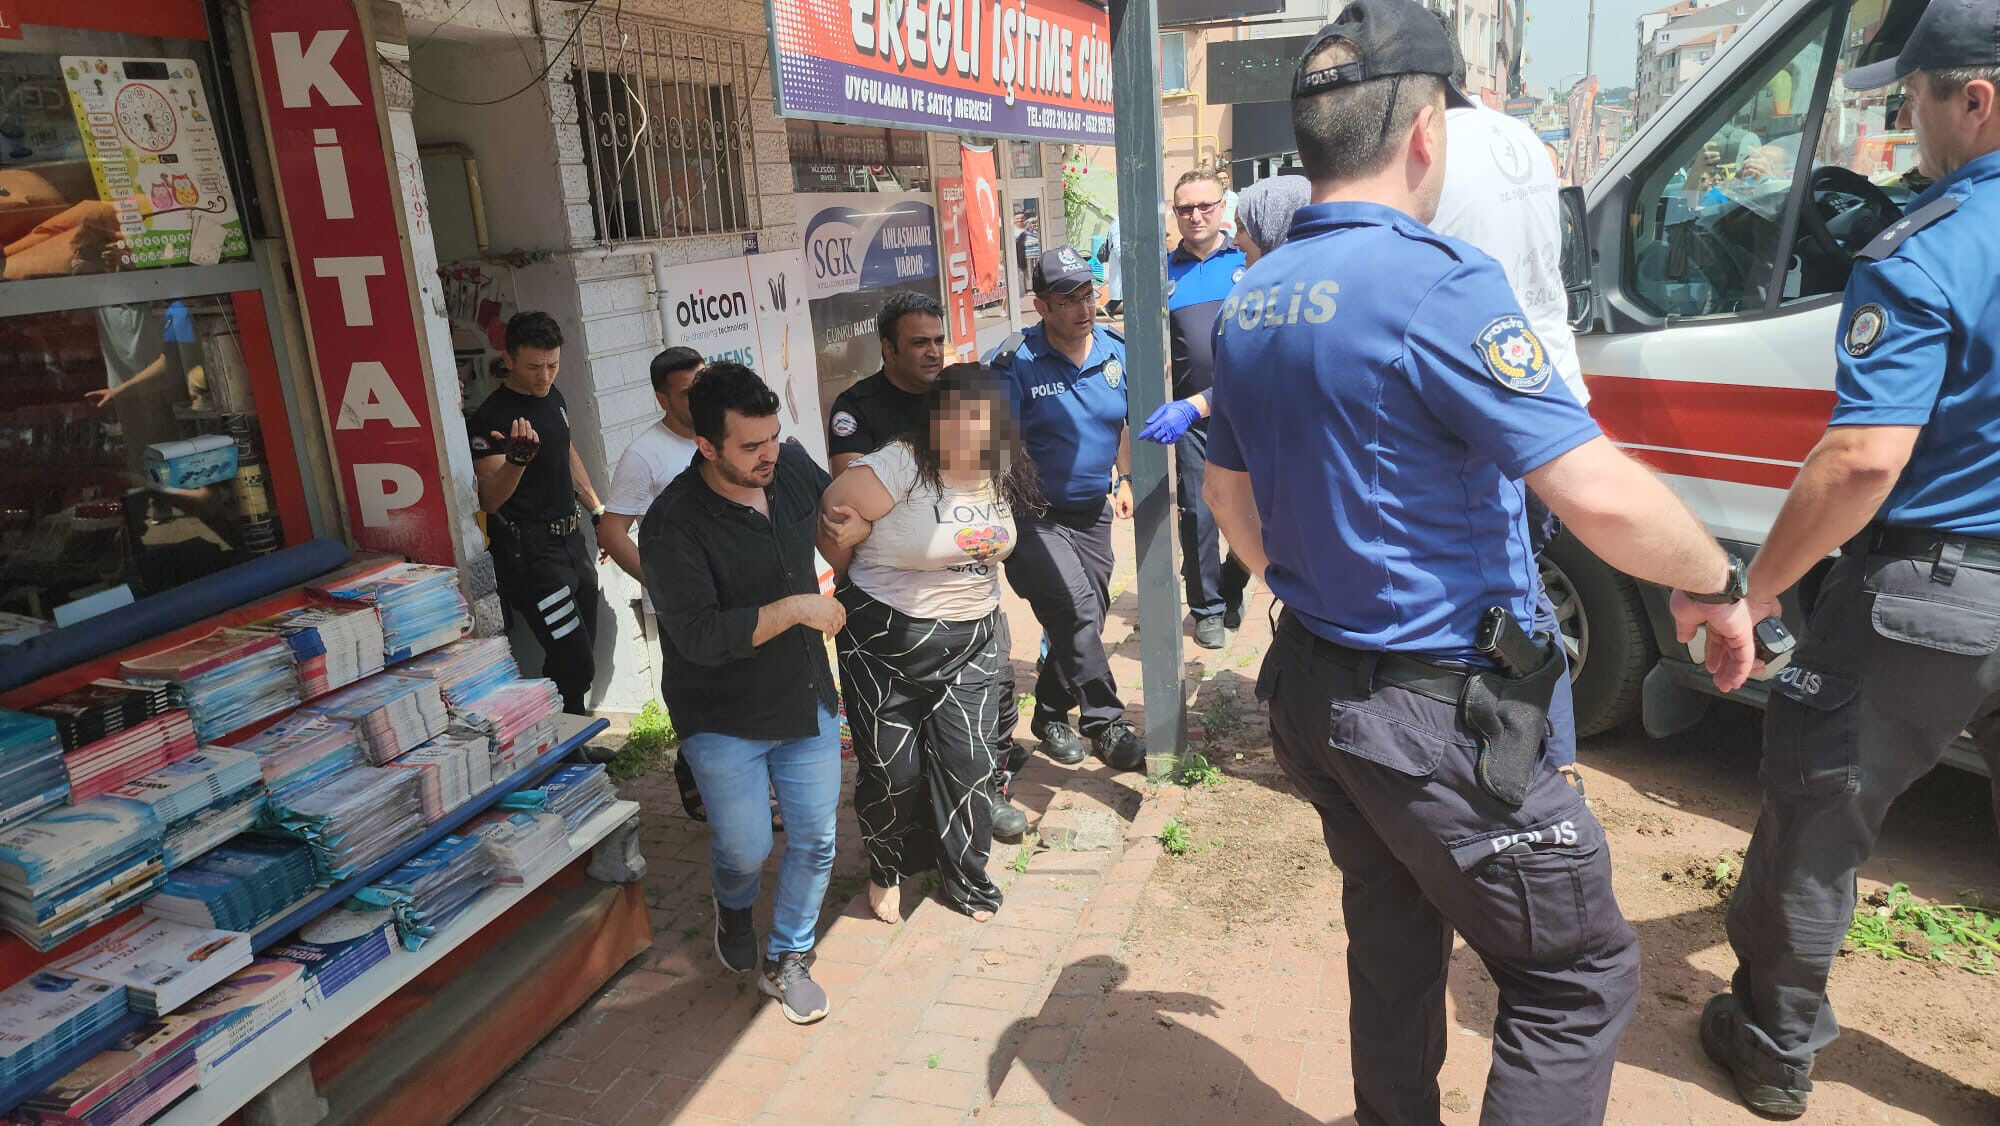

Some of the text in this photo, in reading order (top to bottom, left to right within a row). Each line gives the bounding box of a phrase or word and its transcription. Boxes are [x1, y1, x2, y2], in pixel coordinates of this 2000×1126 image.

[845, 75, 992, 122] UYGULAMA VE SATIŞ MERKEZİ
[882, 226, 931, 254] ANLAŞMAMIZ
[814, 238, 857, 278] SGK
[895, 255, 924, 277] VARDIR
[270, 30, 424, 527] KİTAP
[677, 288, 747, 327] oticon
[718, 322, 749, 334] technology
[854, 318, 876, 337] HAYAT
[704, 346, 754, 367] MENS
